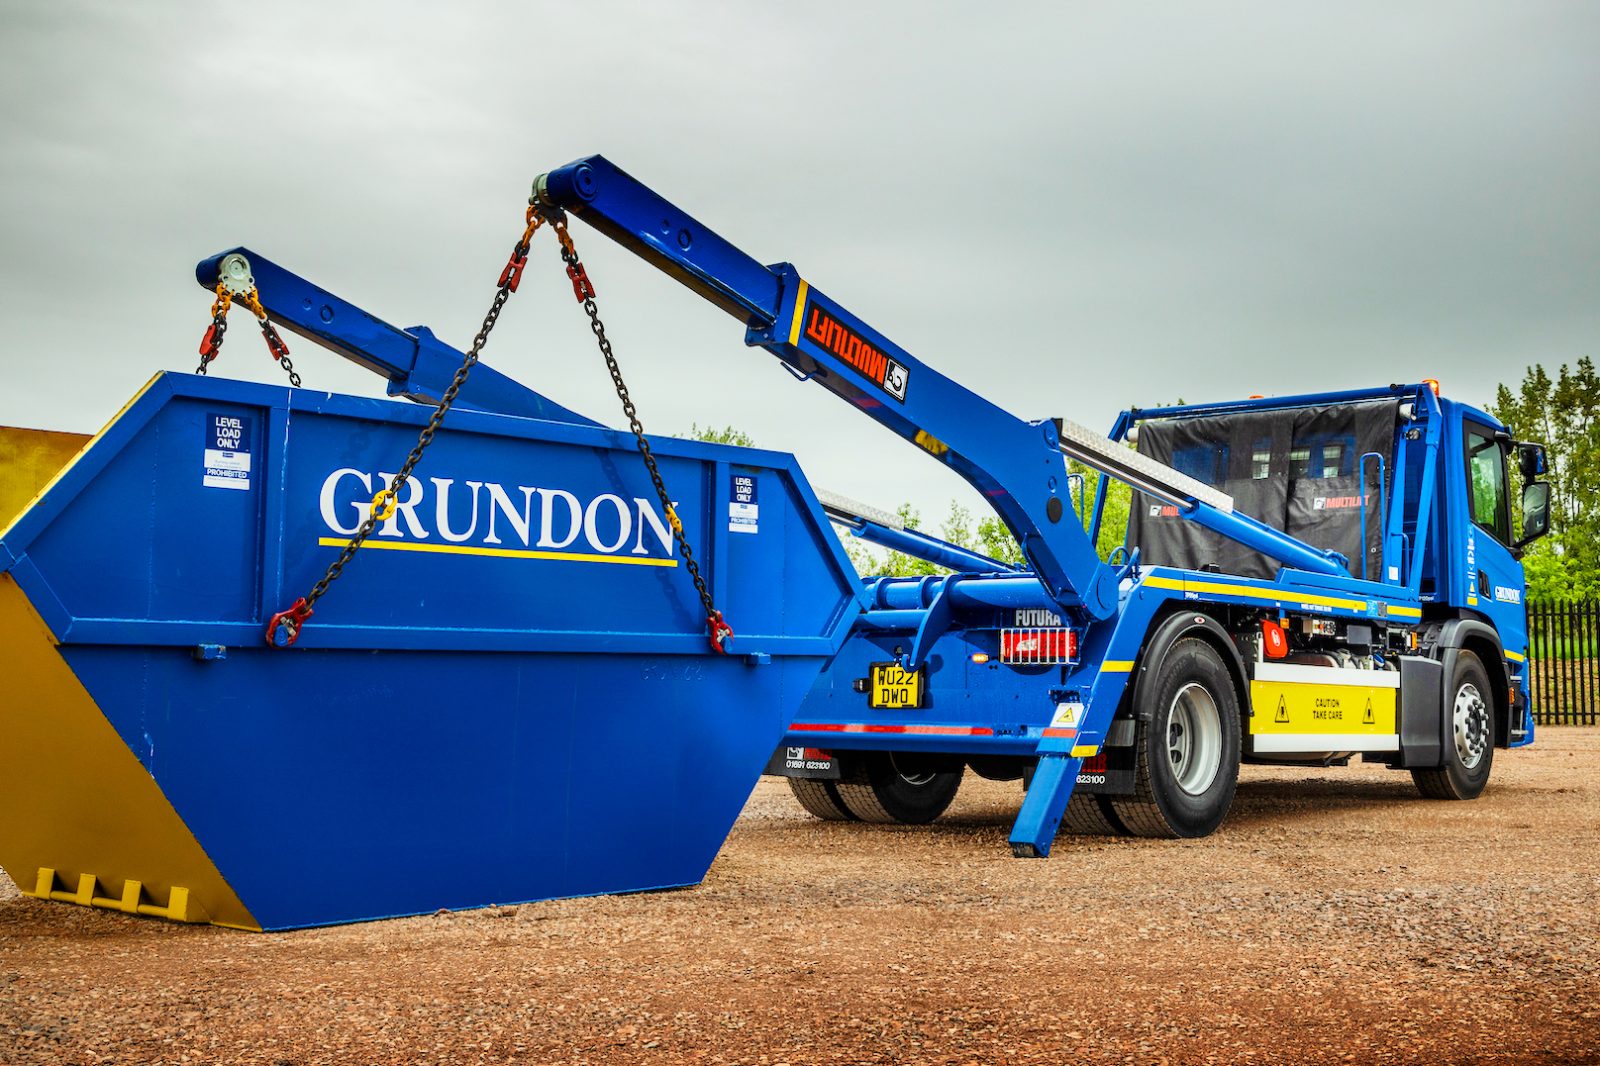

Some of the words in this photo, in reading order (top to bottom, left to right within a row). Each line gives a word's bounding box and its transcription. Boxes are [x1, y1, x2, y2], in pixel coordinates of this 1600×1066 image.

[807, 308, 887, 385] MULTILIFT
[216, 417, 242, 428] LEVEL
[217, 427, 241, 438] LOAD
[217, 438, 240, 448] ONLY
[207, 468, 247, 478] PROHIBITED
[1326, 494, 1370, 509] MULTILIT
[319, 467, 678, 557] GRUNDON
[1015, 609, 1062, 627] FUTURA
[878, 669, 914, 685] WU22
[881, 688, 908, 704] DWO
[1315, 698, 1340, 708] CAUTION
[1312, 710, 1327, 720] TAKE
[1328, 710, 1343, 720] CARE
[806, 761, 831, 770] 623100
[1075, 774, 1106, 784] 623100
